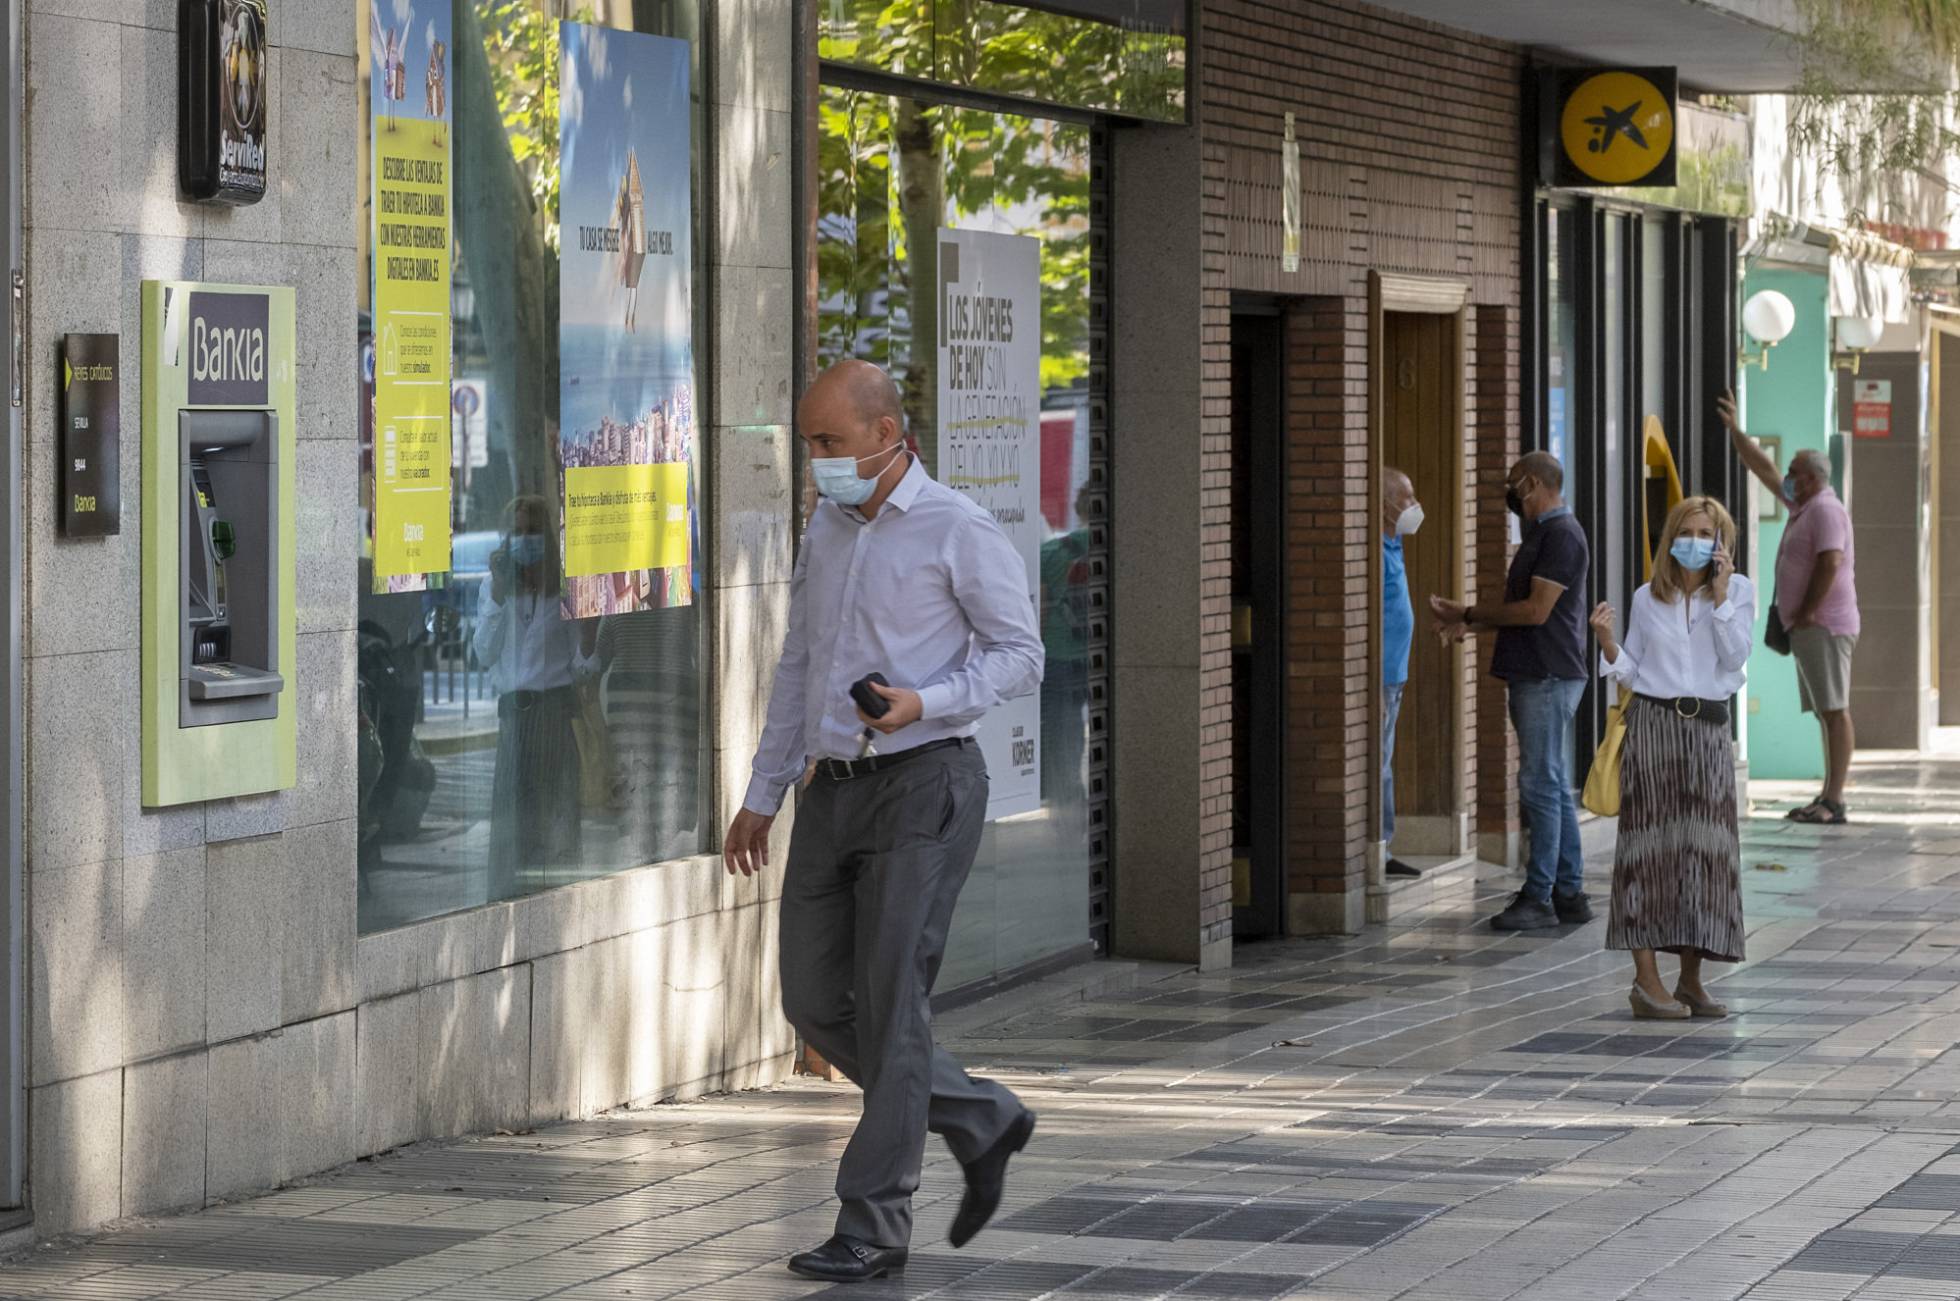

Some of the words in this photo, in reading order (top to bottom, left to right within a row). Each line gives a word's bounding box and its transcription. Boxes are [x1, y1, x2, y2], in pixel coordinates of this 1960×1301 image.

[220, 129, 265, 171] ServiRed
[949, 294, 969, 341] LOS
[970, 281, 1013, 343] JÓVENES
[193, 316, 264, 382] Bankia
[949, 344, 963, 390] DE
[964, 345, 985, 391] HOY
[986, 346, 1007, 392] SON
[1399, 359, 1416, 390] 6
[950, 444, 970, 491] DEL
[74, 494, 97, 513] Bankia
